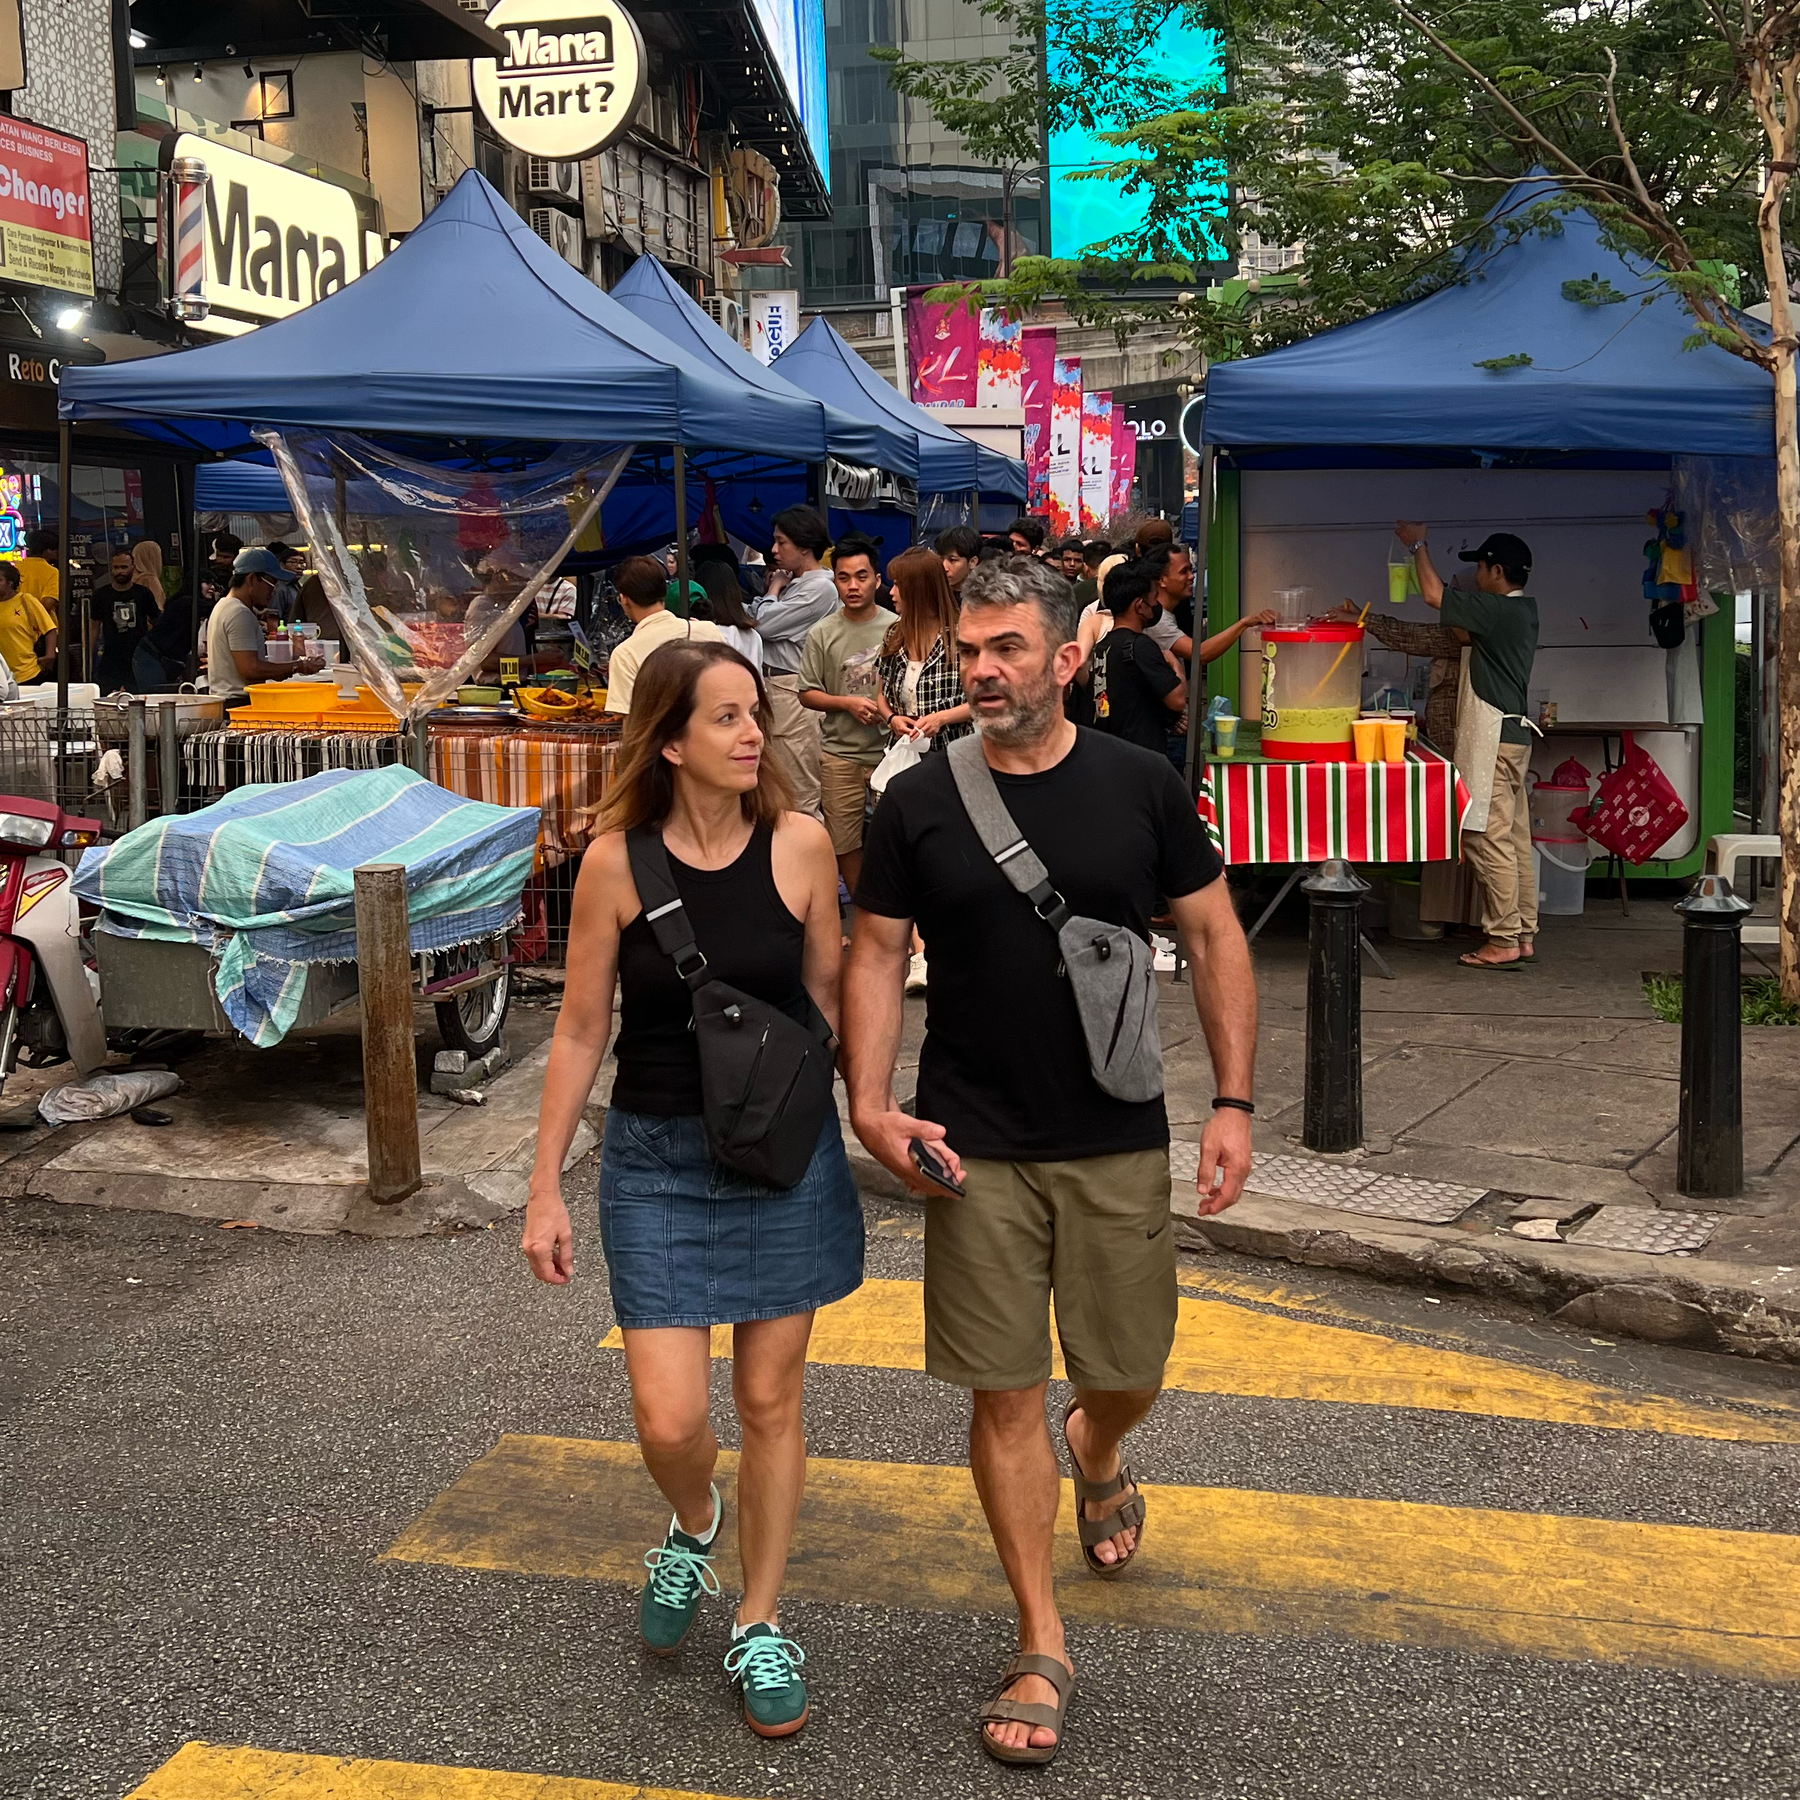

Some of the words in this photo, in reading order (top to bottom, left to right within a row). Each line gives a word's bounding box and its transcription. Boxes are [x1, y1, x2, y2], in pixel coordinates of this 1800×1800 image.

[503, 29, 606, 67] Mana
[499, 81, 615, 118] Mart?
[17, 142, 54, 163] BUSINESS
[20, 128, 43, 145] WANG
[44, 136, 82, 157] BERLESEN
[0, 164, 85, 220] Changer
[7, 238, 18, 252] The
[18, 241, 37, 256] fastest
[37, 248, 48, 260] way
[48, 249, 55, 260] to
[205, 174, 346, 303] Mana
[8, 253, 22, 267] Send
[28, 257, 48, 272] Receive
[49, 261, 66, 278] Money
[66, 266, 92, 281] Worldwide
[768, 305, 782, 361] OGUE
[8, 353, 45, 382] Reto
[1022, 379, 1044, 408] L
[69, 535, 93, 544] ELCOME
